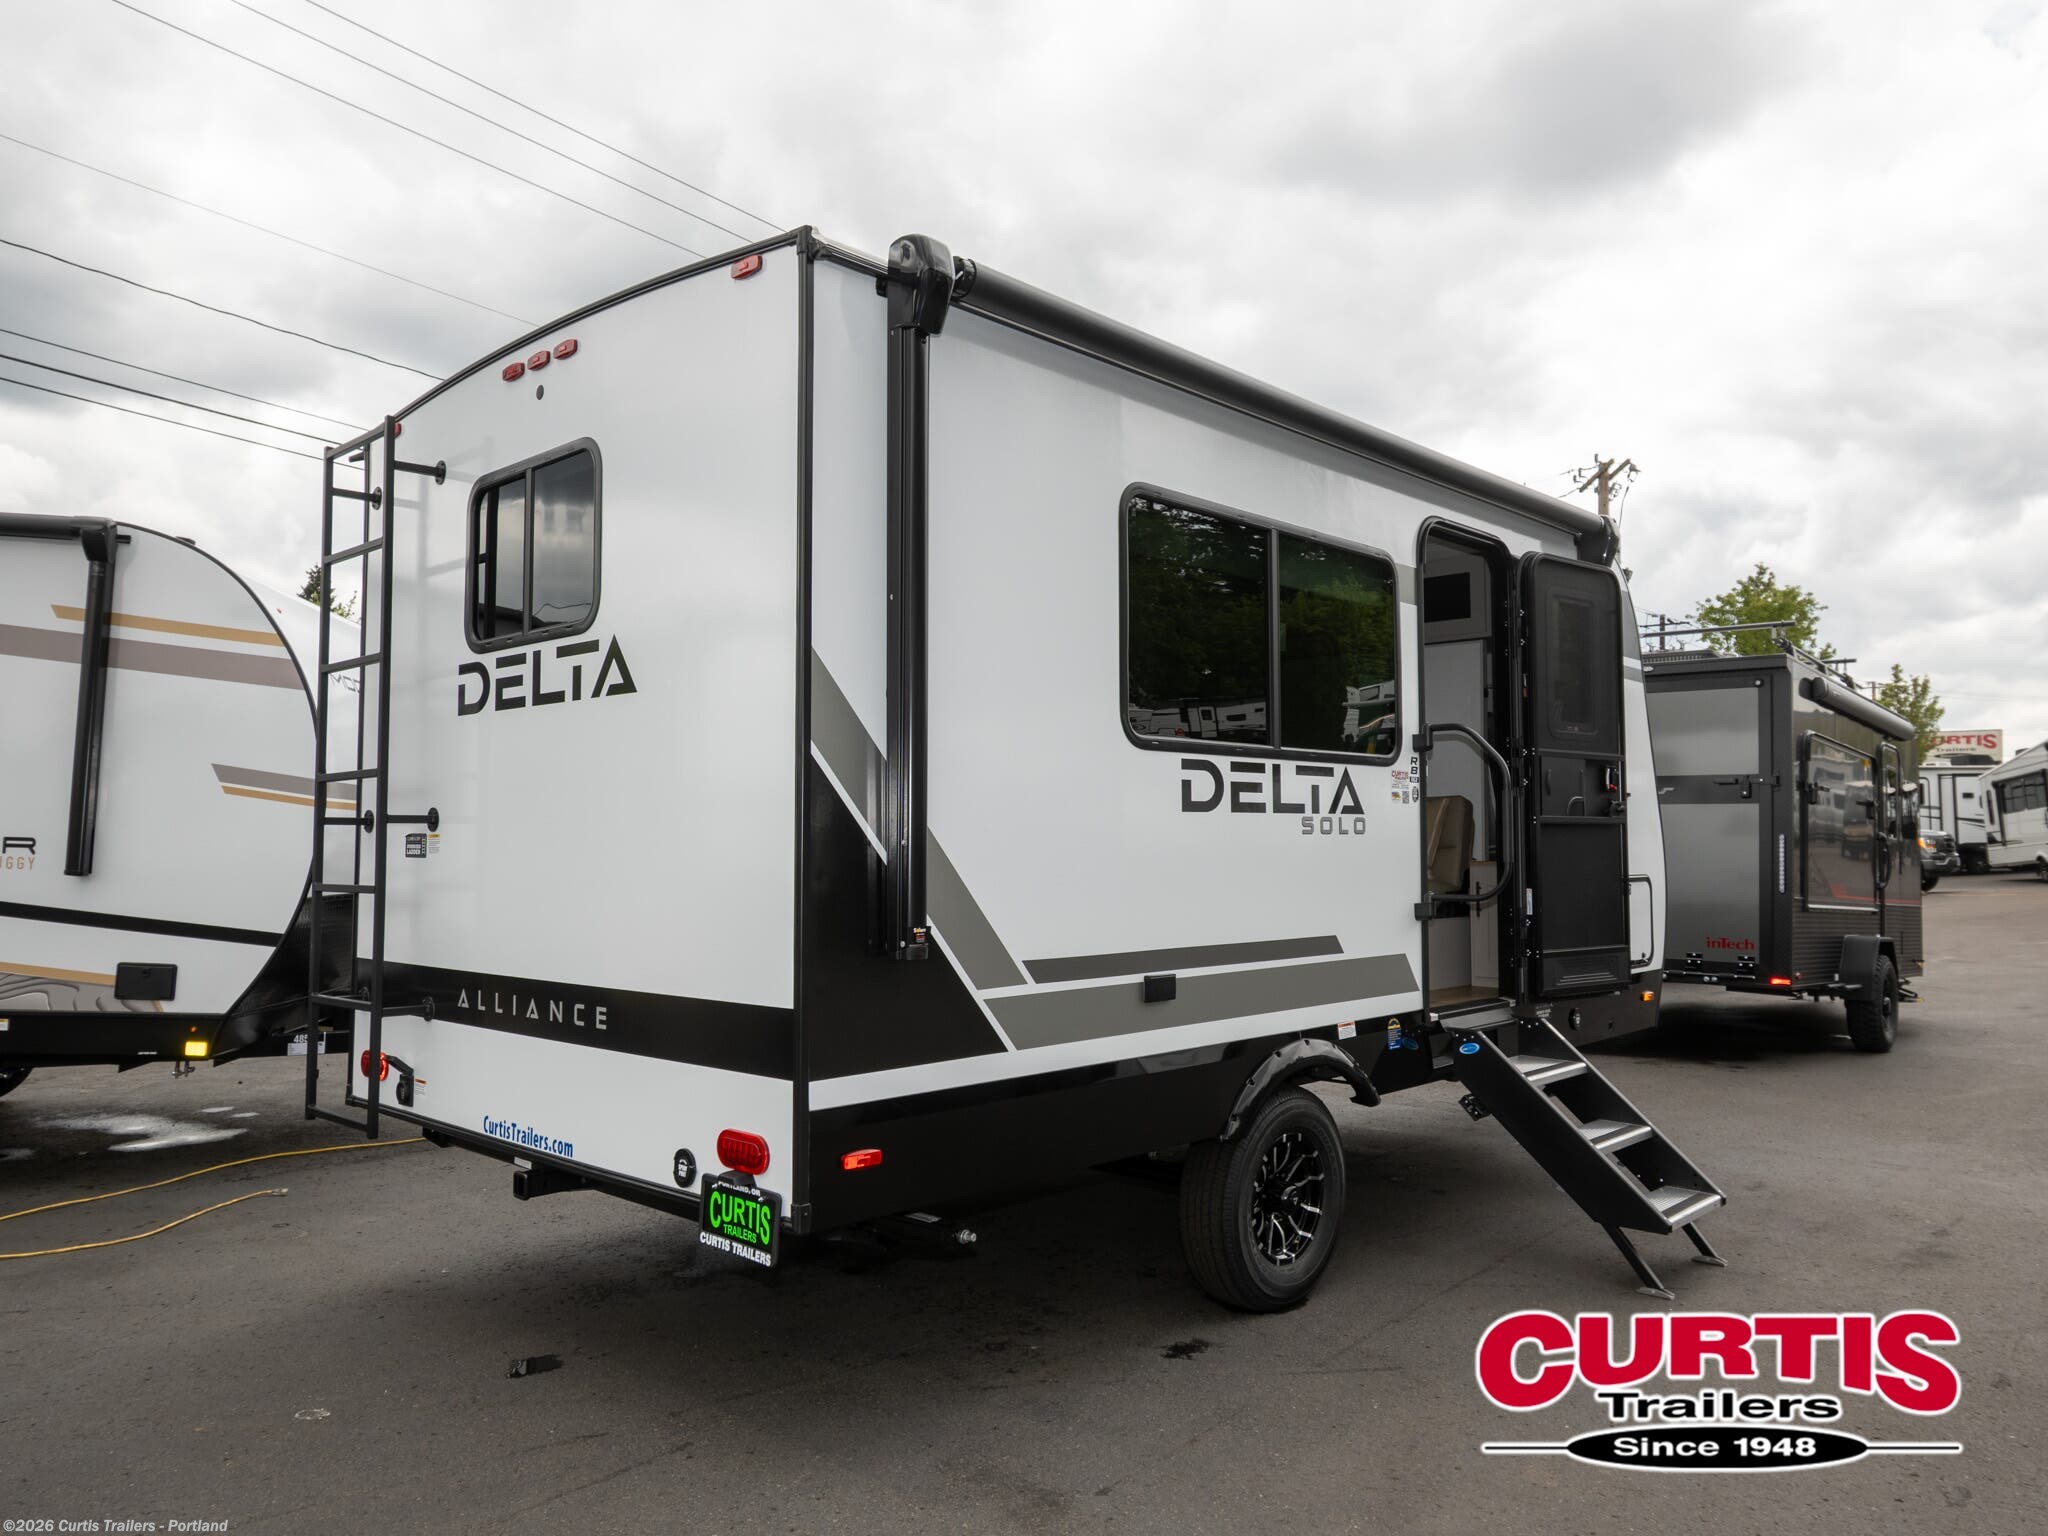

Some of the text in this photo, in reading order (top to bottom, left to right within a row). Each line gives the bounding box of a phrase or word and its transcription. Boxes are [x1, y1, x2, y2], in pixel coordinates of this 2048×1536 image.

[458, 633, 638, 716] DELTA
[1181, 758, 1365, 814] DELTA
[1301, 816, 1366, 835] SOLO
[0, 856, 36, 871] GGY
[2, 836, 36, 855] R
[1706, 936, 1755, 950] inTech
[457, 988, 608, 1031] ALLIANCE
[483, 1115, 574, 1158] CurtisTrailers.com
[709, 1190, 771, 1246] CURTIS
[723, 1223, 757, 1244] TRAILERS
[700, 1231, 772, 1267] CURTIS TRAILERS
